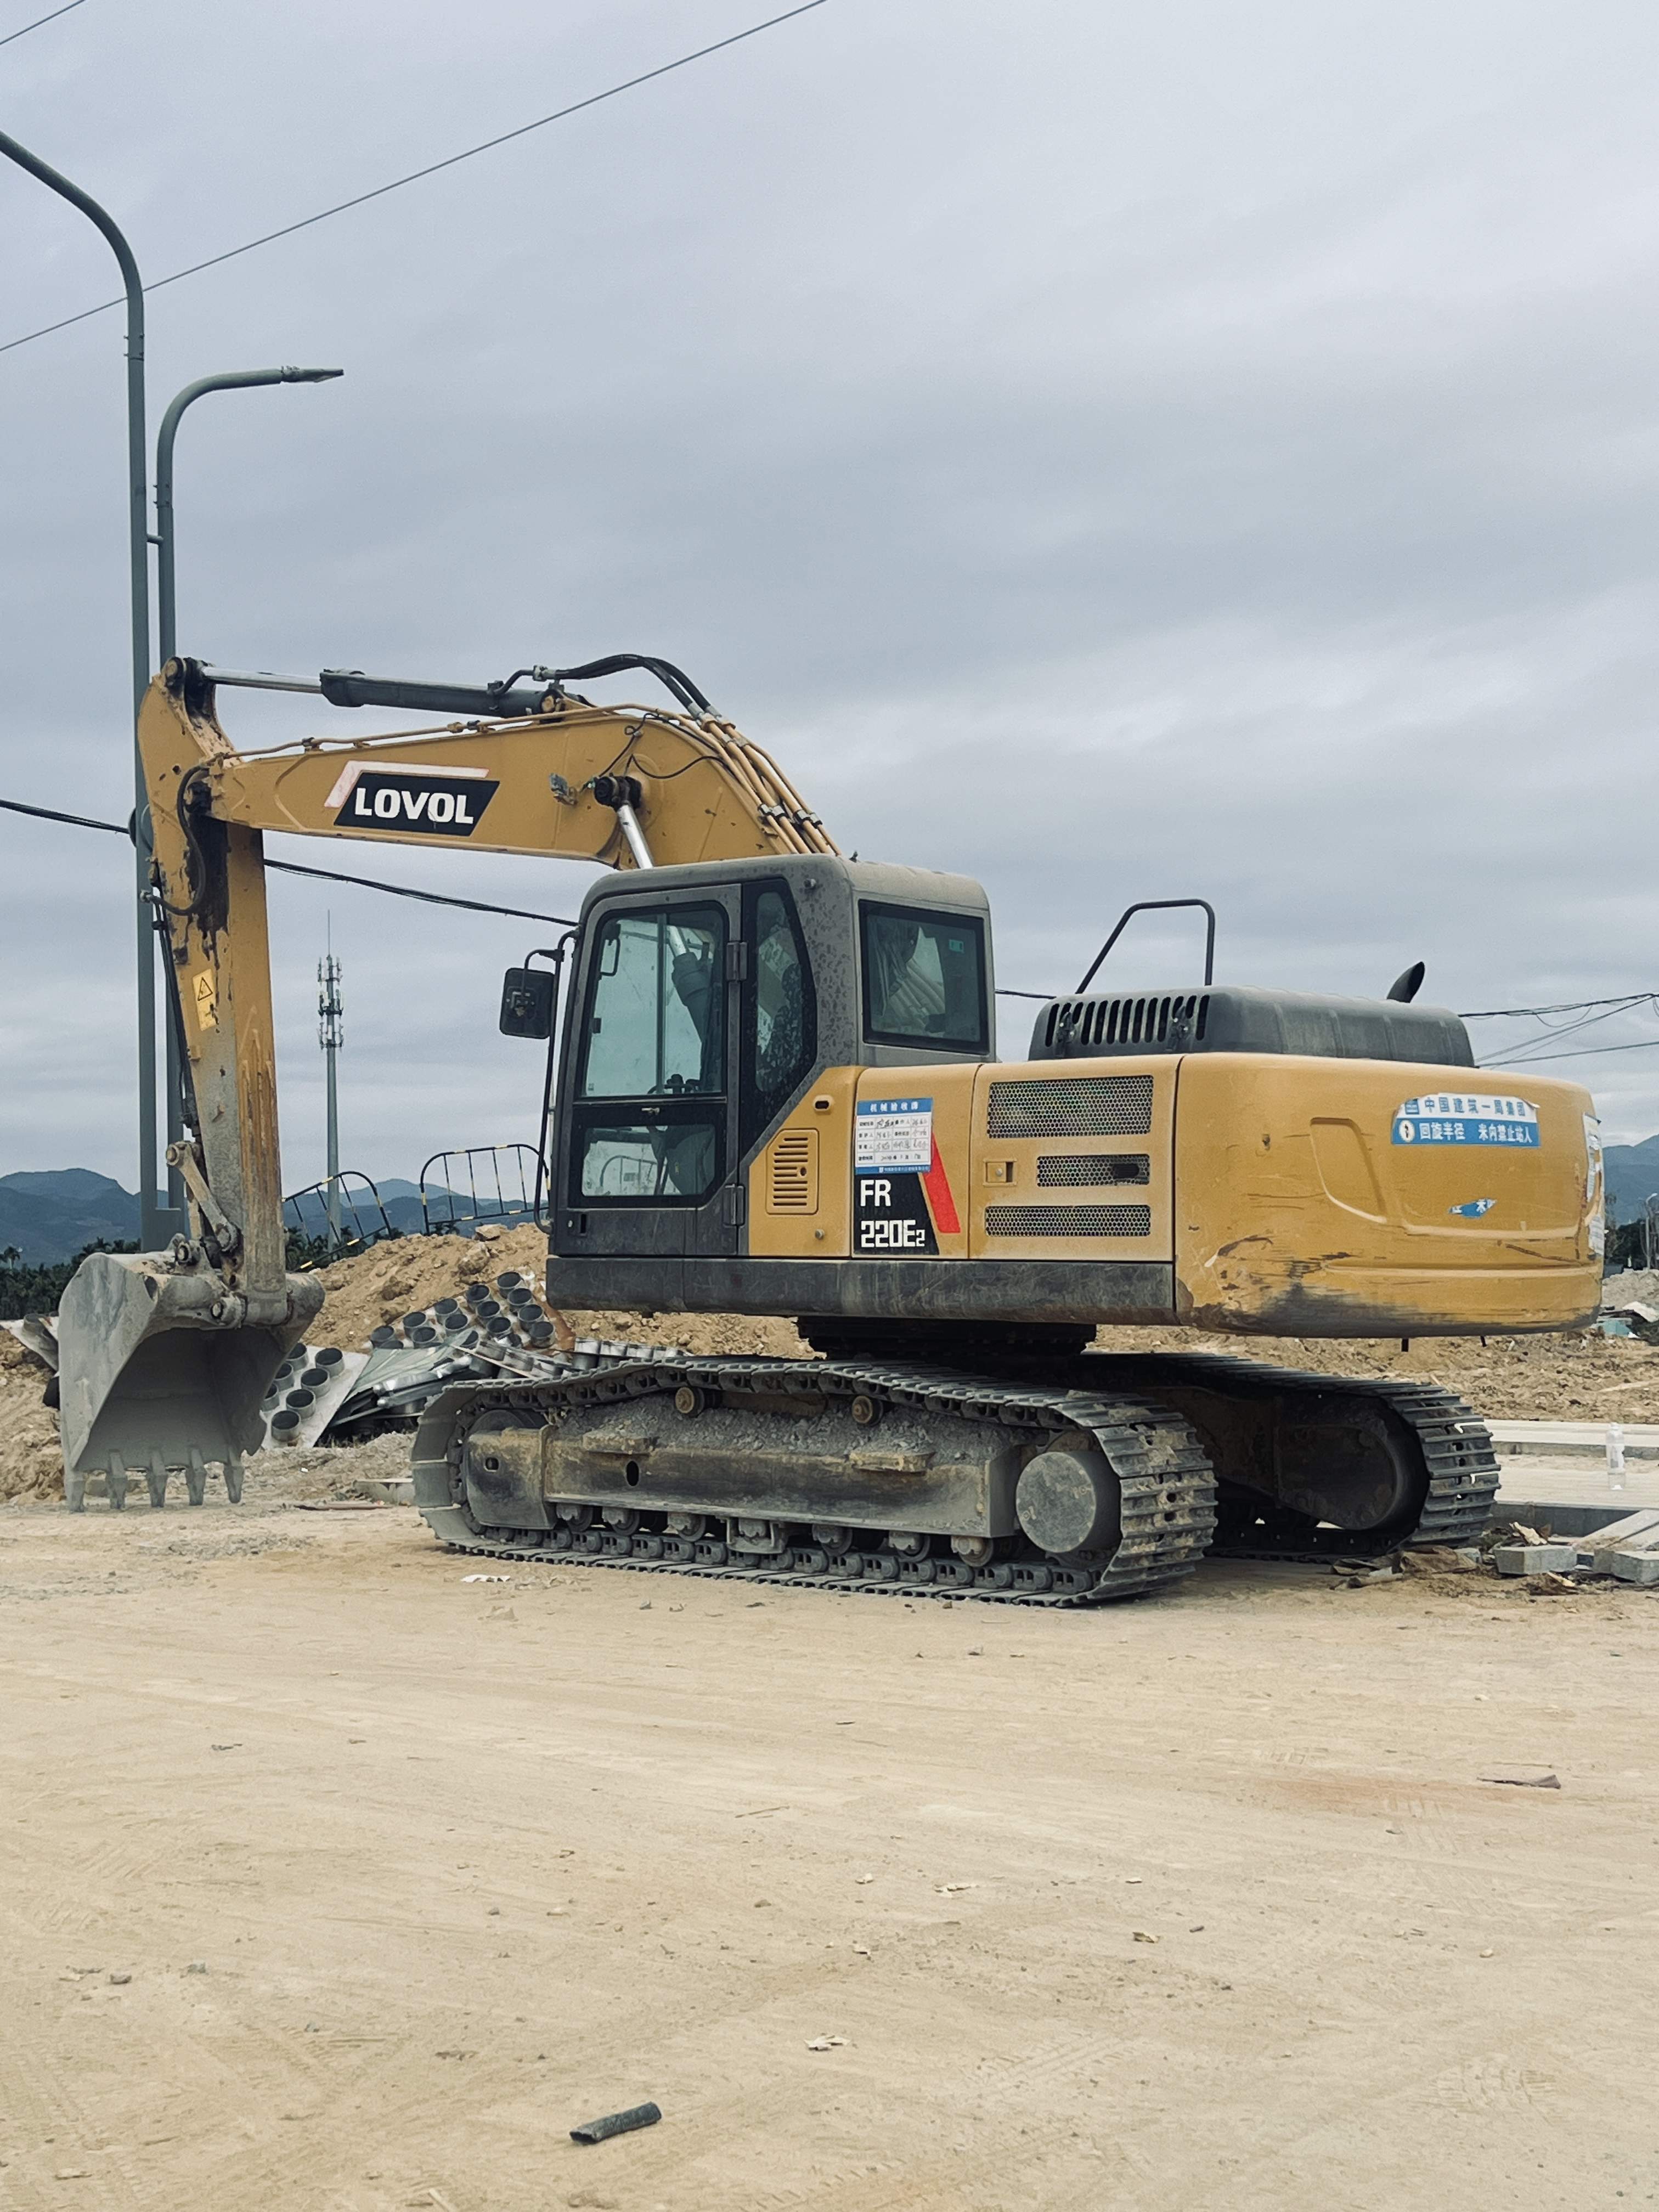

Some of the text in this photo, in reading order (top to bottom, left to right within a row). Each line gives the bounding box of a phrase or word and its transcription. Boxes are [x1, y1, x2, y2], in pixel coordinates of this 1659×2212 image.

[354, 787, 474, 825] LOVOL
[1424, 1097, 1526, 1116] 中国建筑一局集团
[1419, 1121, 1533, 1143] 回旋半径 米内禁止站人
[860, 1179, 891, 1206] FR
[861, 1220, 926, 1248] 220E2
